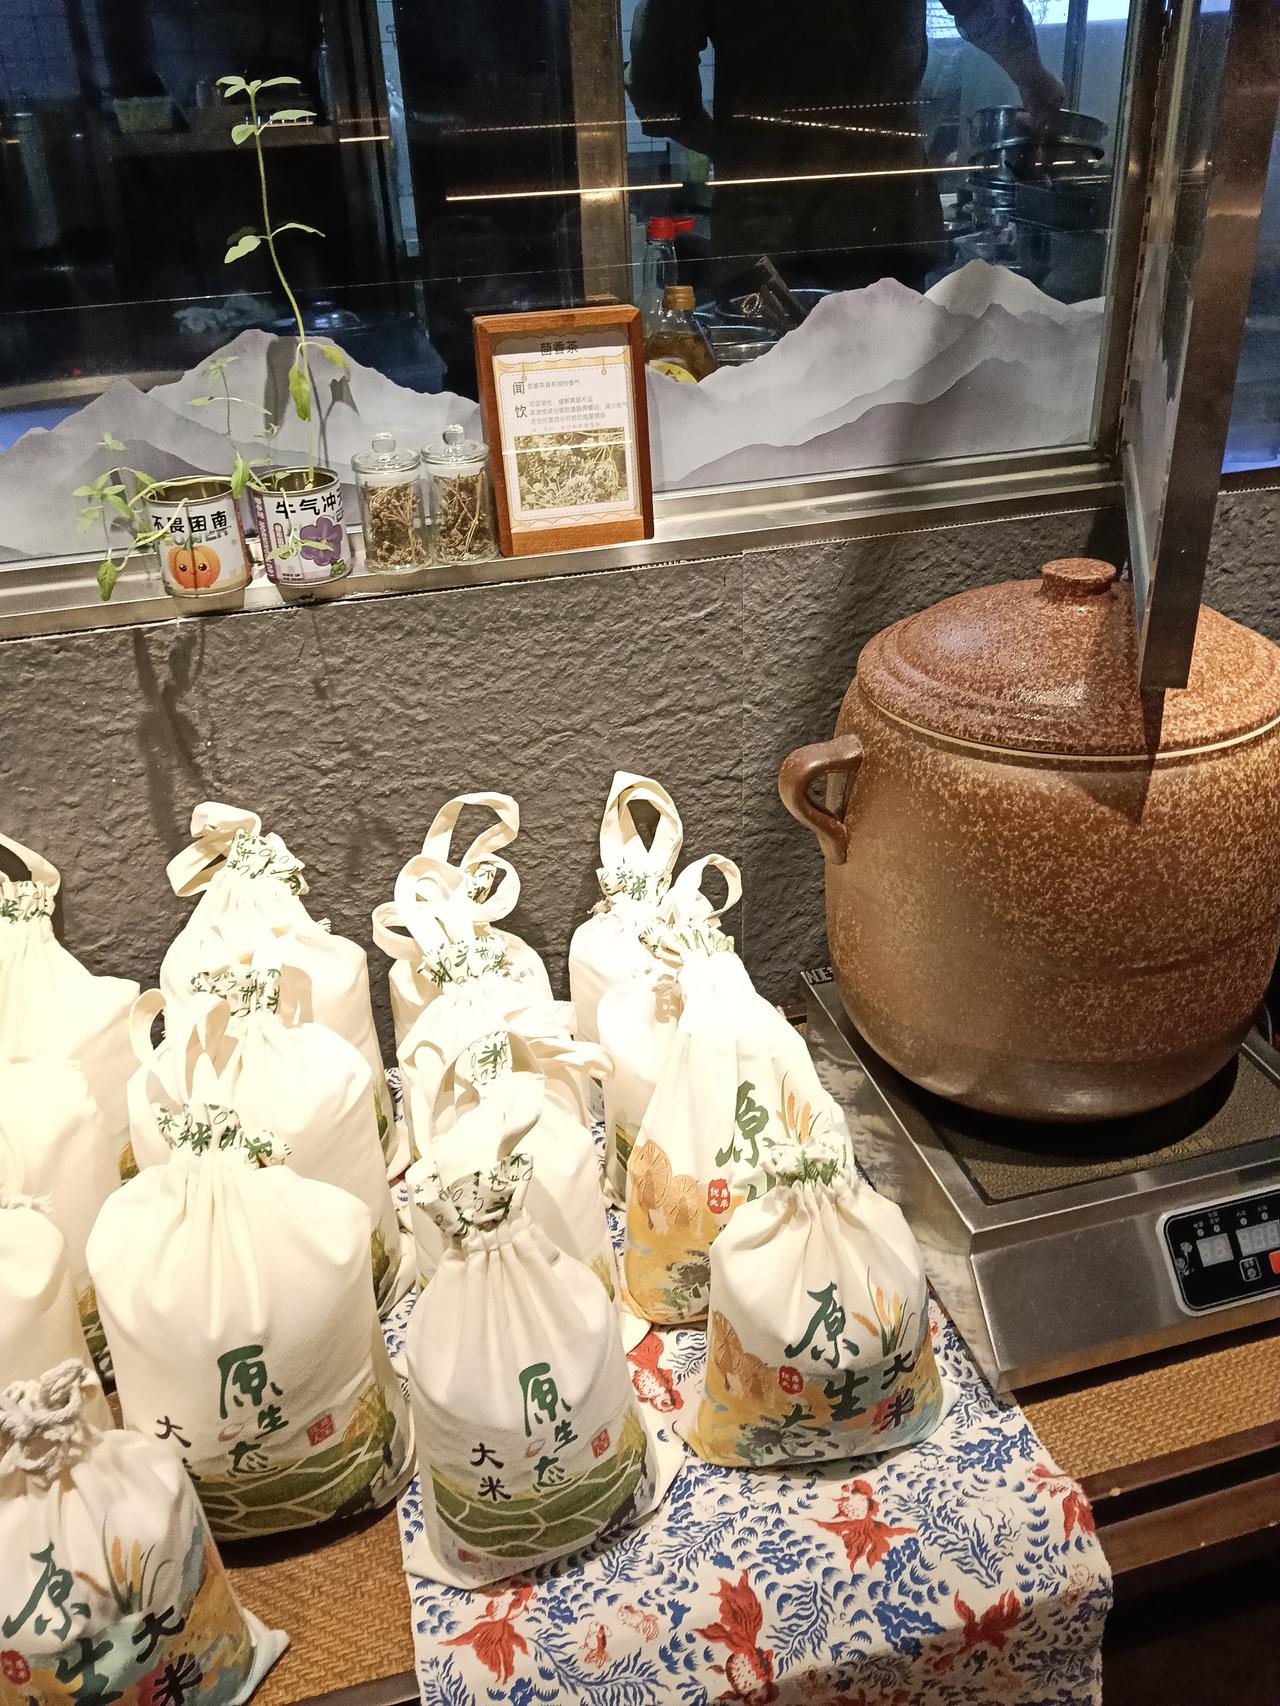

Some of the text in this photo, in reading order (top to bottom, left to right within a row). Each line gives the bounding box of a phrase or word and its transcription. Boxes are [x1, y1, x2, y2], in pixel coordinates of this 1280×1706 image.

[539, 340, 579, 356] 茴香茶
[512, 381, 525, 395] 闻
[514, 405, 528, 419] 饮
[217, 1344, 289, 1478] 原生态
[519, 1362, 579, 1493] 原生态
[470, 1442, 512, 1502] 大米
